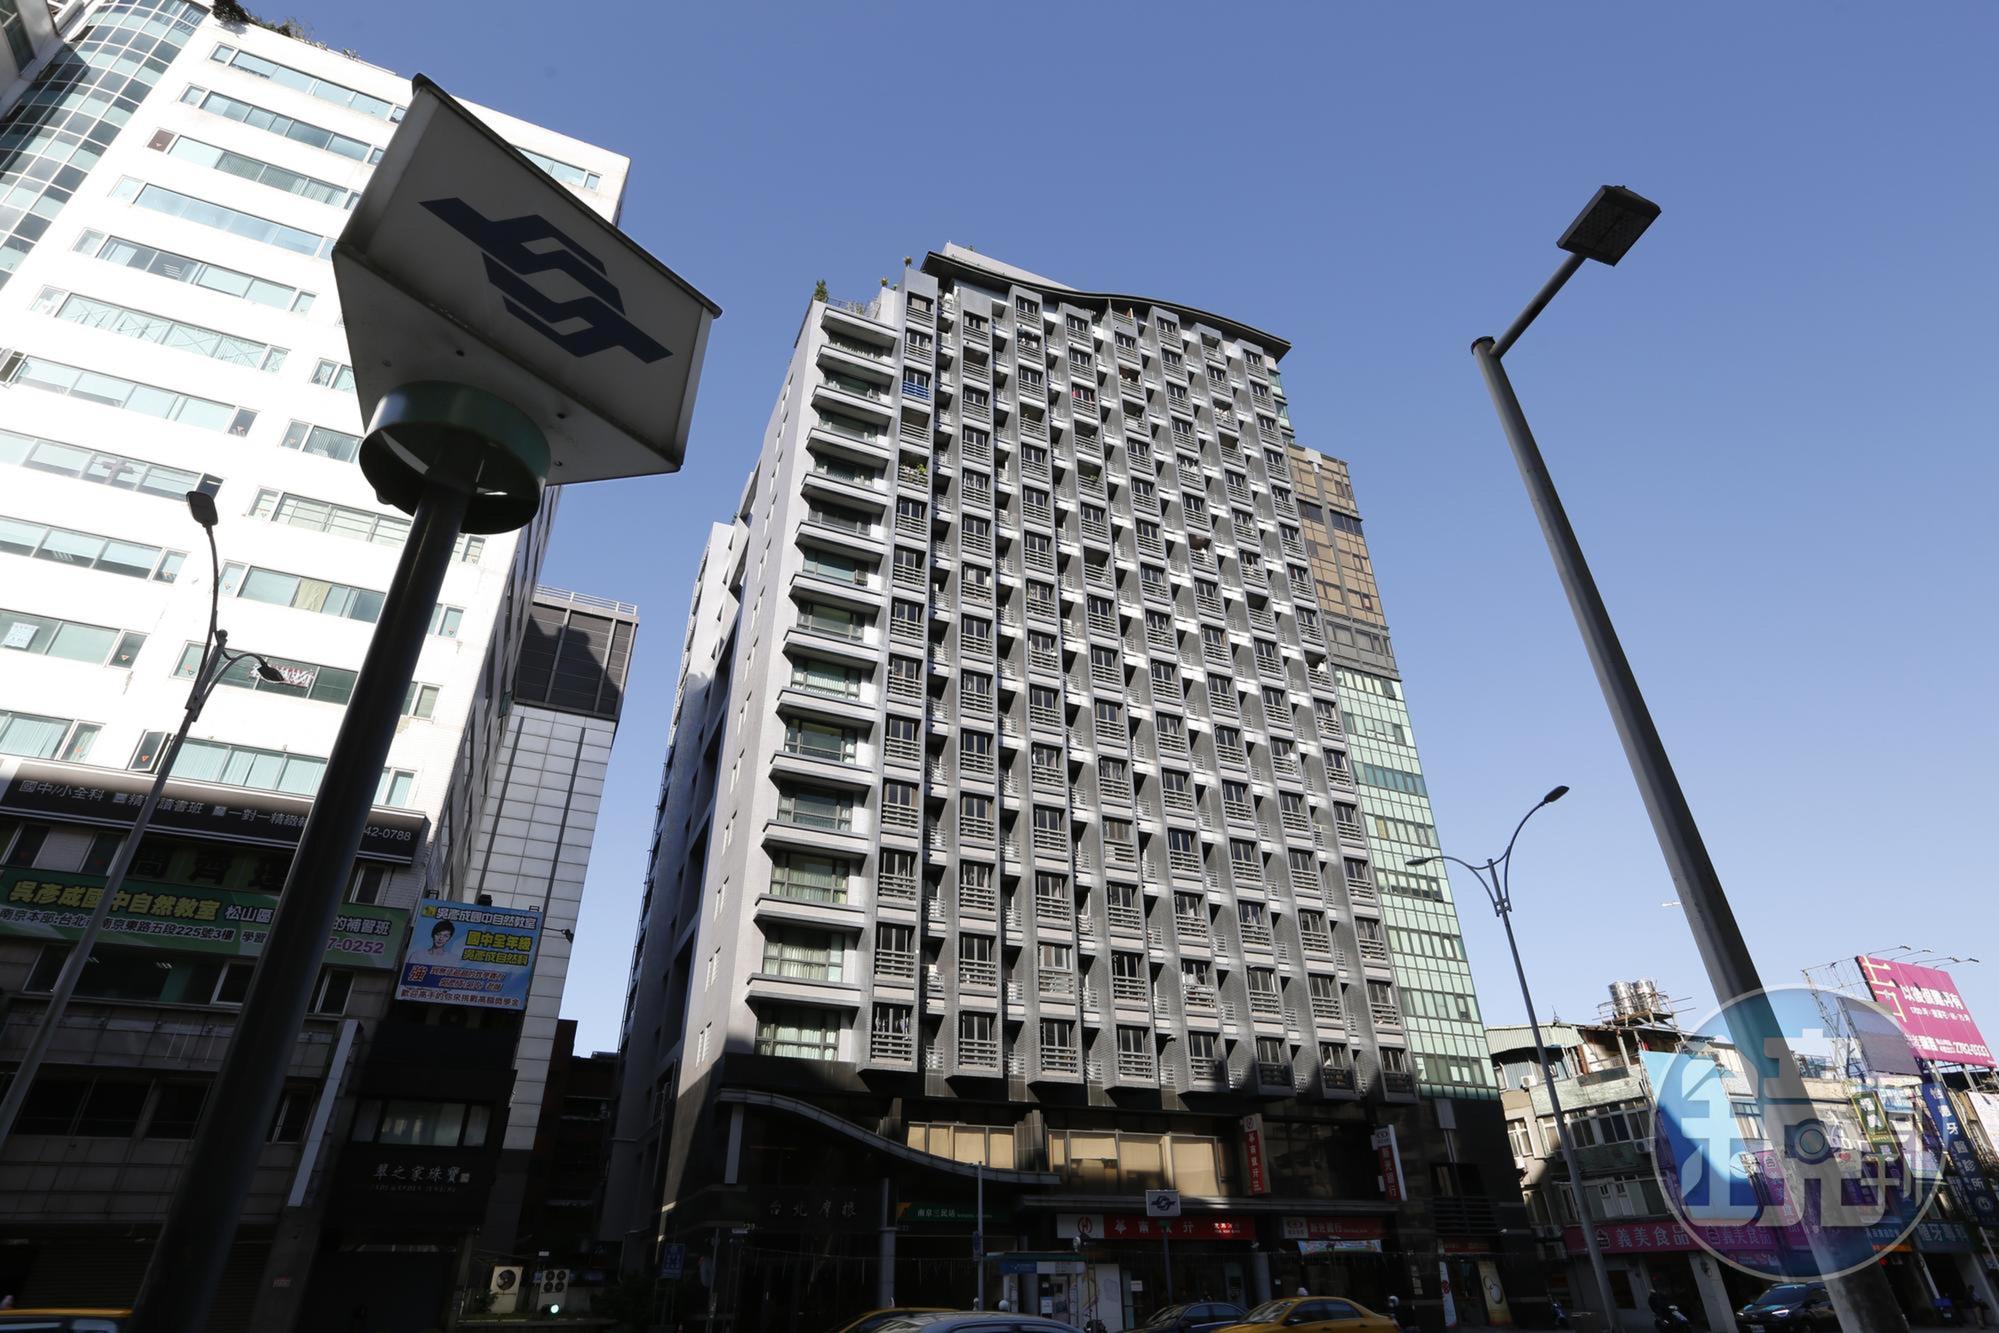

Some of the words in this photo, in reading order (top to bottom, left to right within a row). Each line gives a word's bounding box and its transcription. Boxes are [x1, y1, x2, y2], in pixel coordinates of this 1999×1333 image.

[19, 780, 105, 802] 國中/小全科
[127, 793, 205, 815] 精讀書班
[9, 880, 221, 920] 吳彥成國中自然教室
[1616, 1224, 1690, 1248] 義美食品
